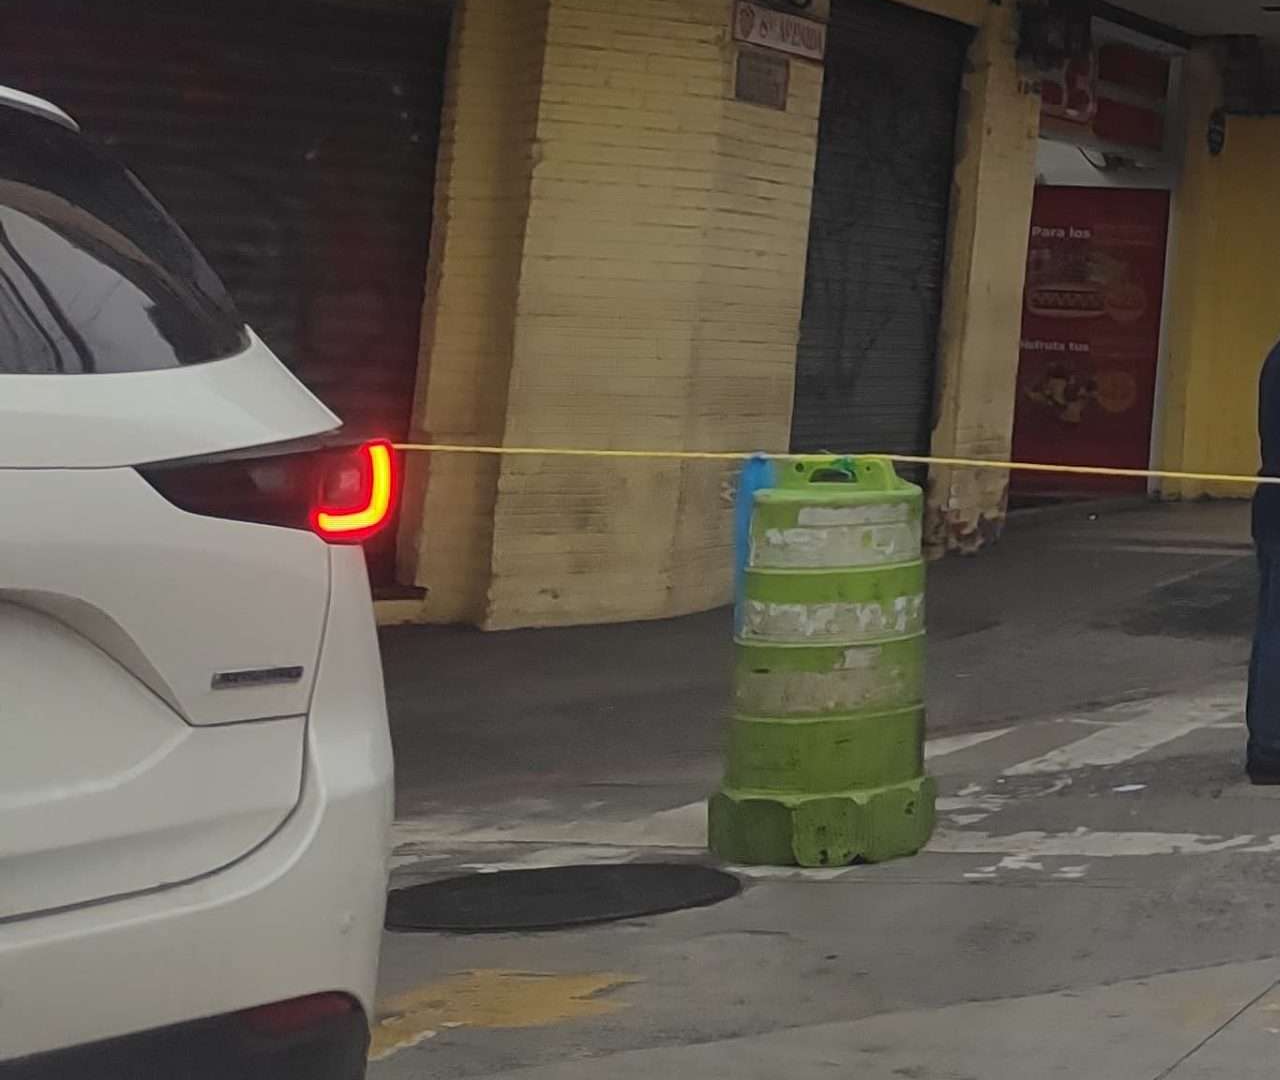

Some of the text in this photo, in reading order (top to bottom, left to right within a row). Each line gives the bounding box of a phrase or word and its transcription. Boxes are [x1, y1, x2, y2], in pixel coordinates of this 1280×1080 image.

[1031, 226, 1065, 238] Para
[1069, 226, 1091, 238] los
[1068, 341, 1090, 352] tus
